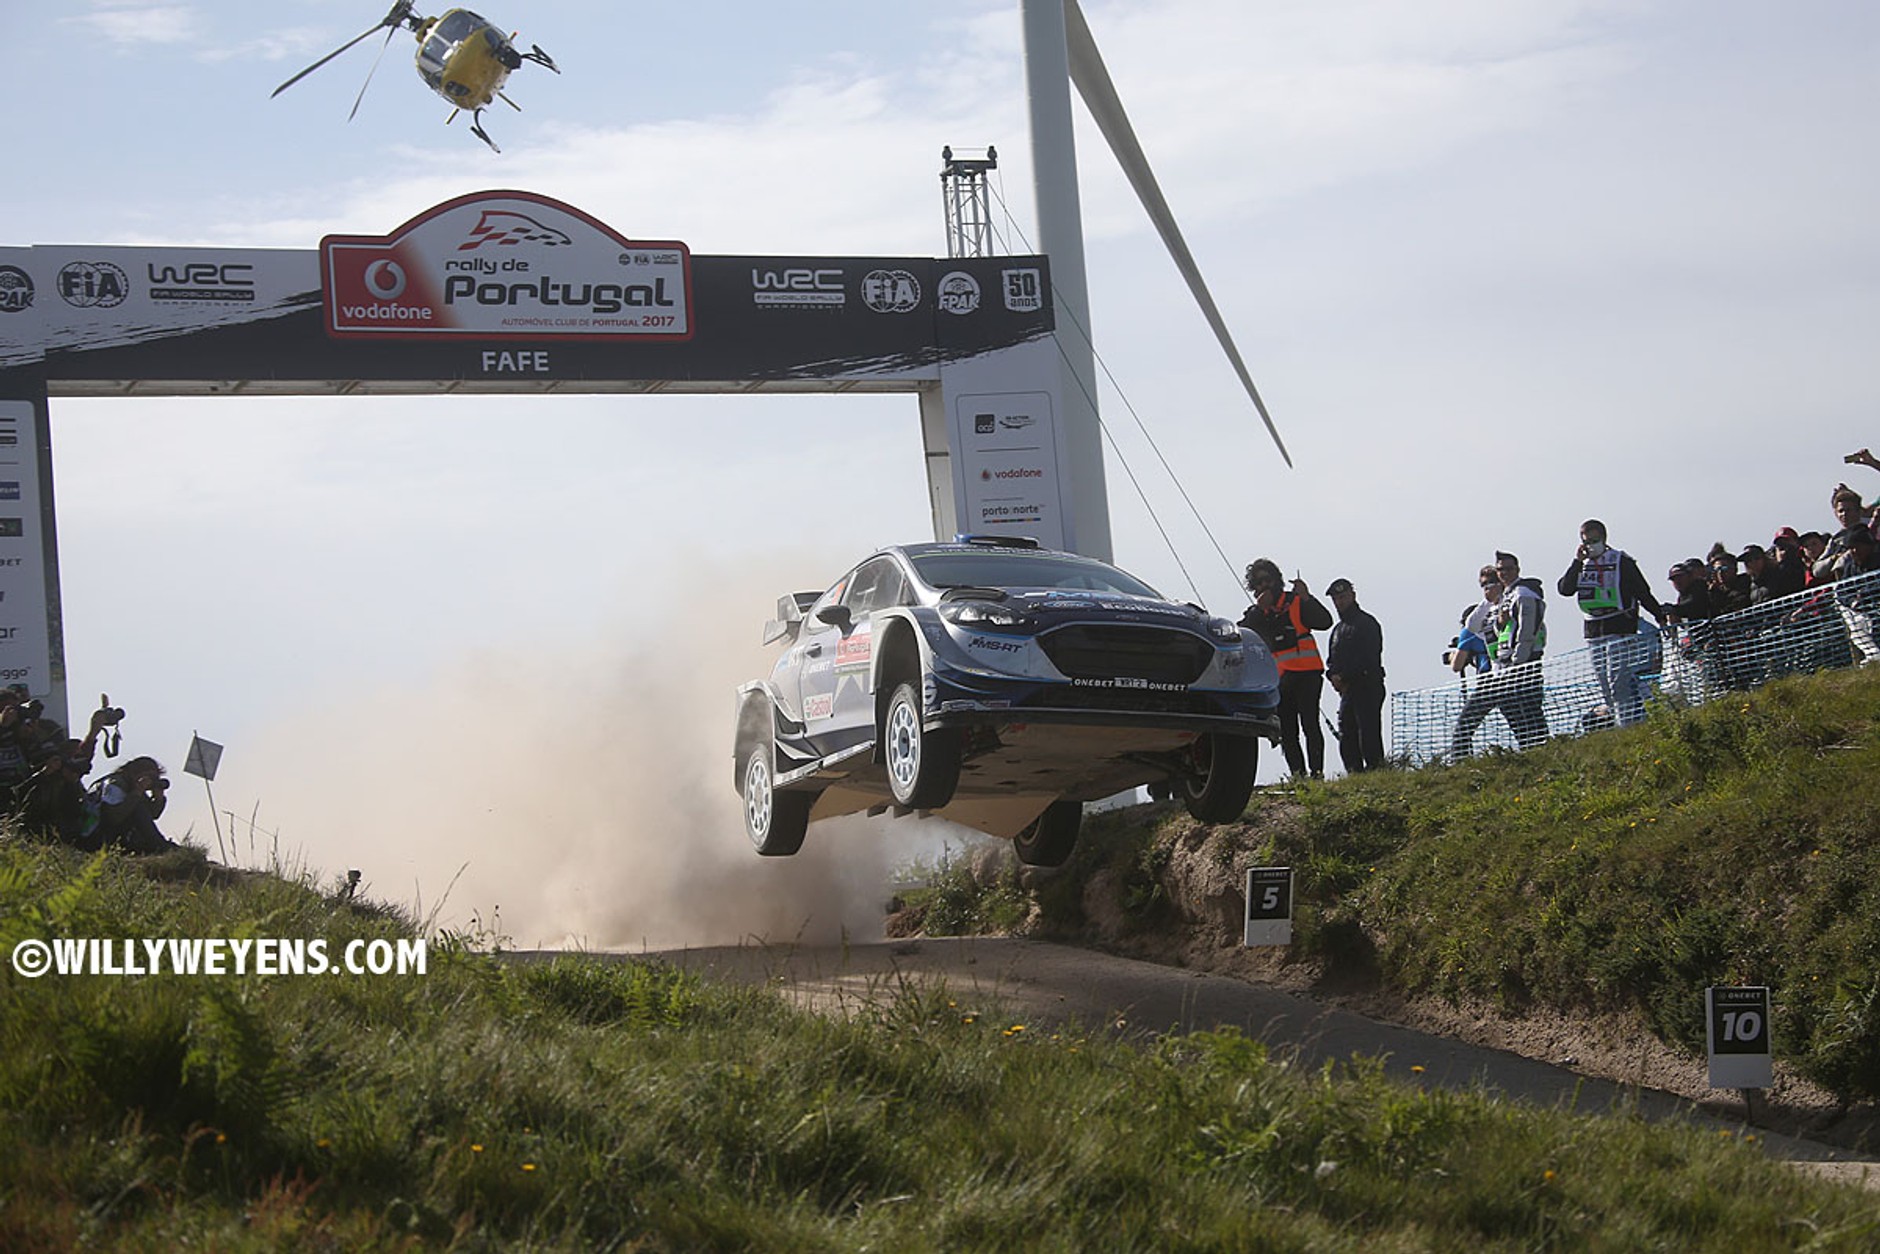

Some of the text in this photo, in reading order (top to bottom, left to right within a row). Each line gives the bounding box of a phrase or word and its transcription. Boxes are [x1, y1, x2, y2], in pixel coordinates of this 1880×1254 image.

[148, 263, 254, 285] WRC
[445, 258, 529, 274] rally de
[752, 269, 845, 289] WRC
[1009, 273, 1036, 297] 50
[444, 276, 674, 314] Portugal
[938, 294, 980, 310] FPAK
[342, 302, 432, 321] vodafone
[555, 318, 577, 327] CLUB
[579, 318, 590, 327] DE
[592, 318, 639, 328] PORTUGAL
[642, 315, 675, 327] 2017
[482, 351, 549, 372] FAFE
[995, 467, 1042, 479] vodafone
[1074, 678, 1114, 687] ONEBET
[1149, 681, 1186, 691] ONEBET
[1262, 886, 1280, 910] 5
[1722, 1011, 1762, 1041] 10
